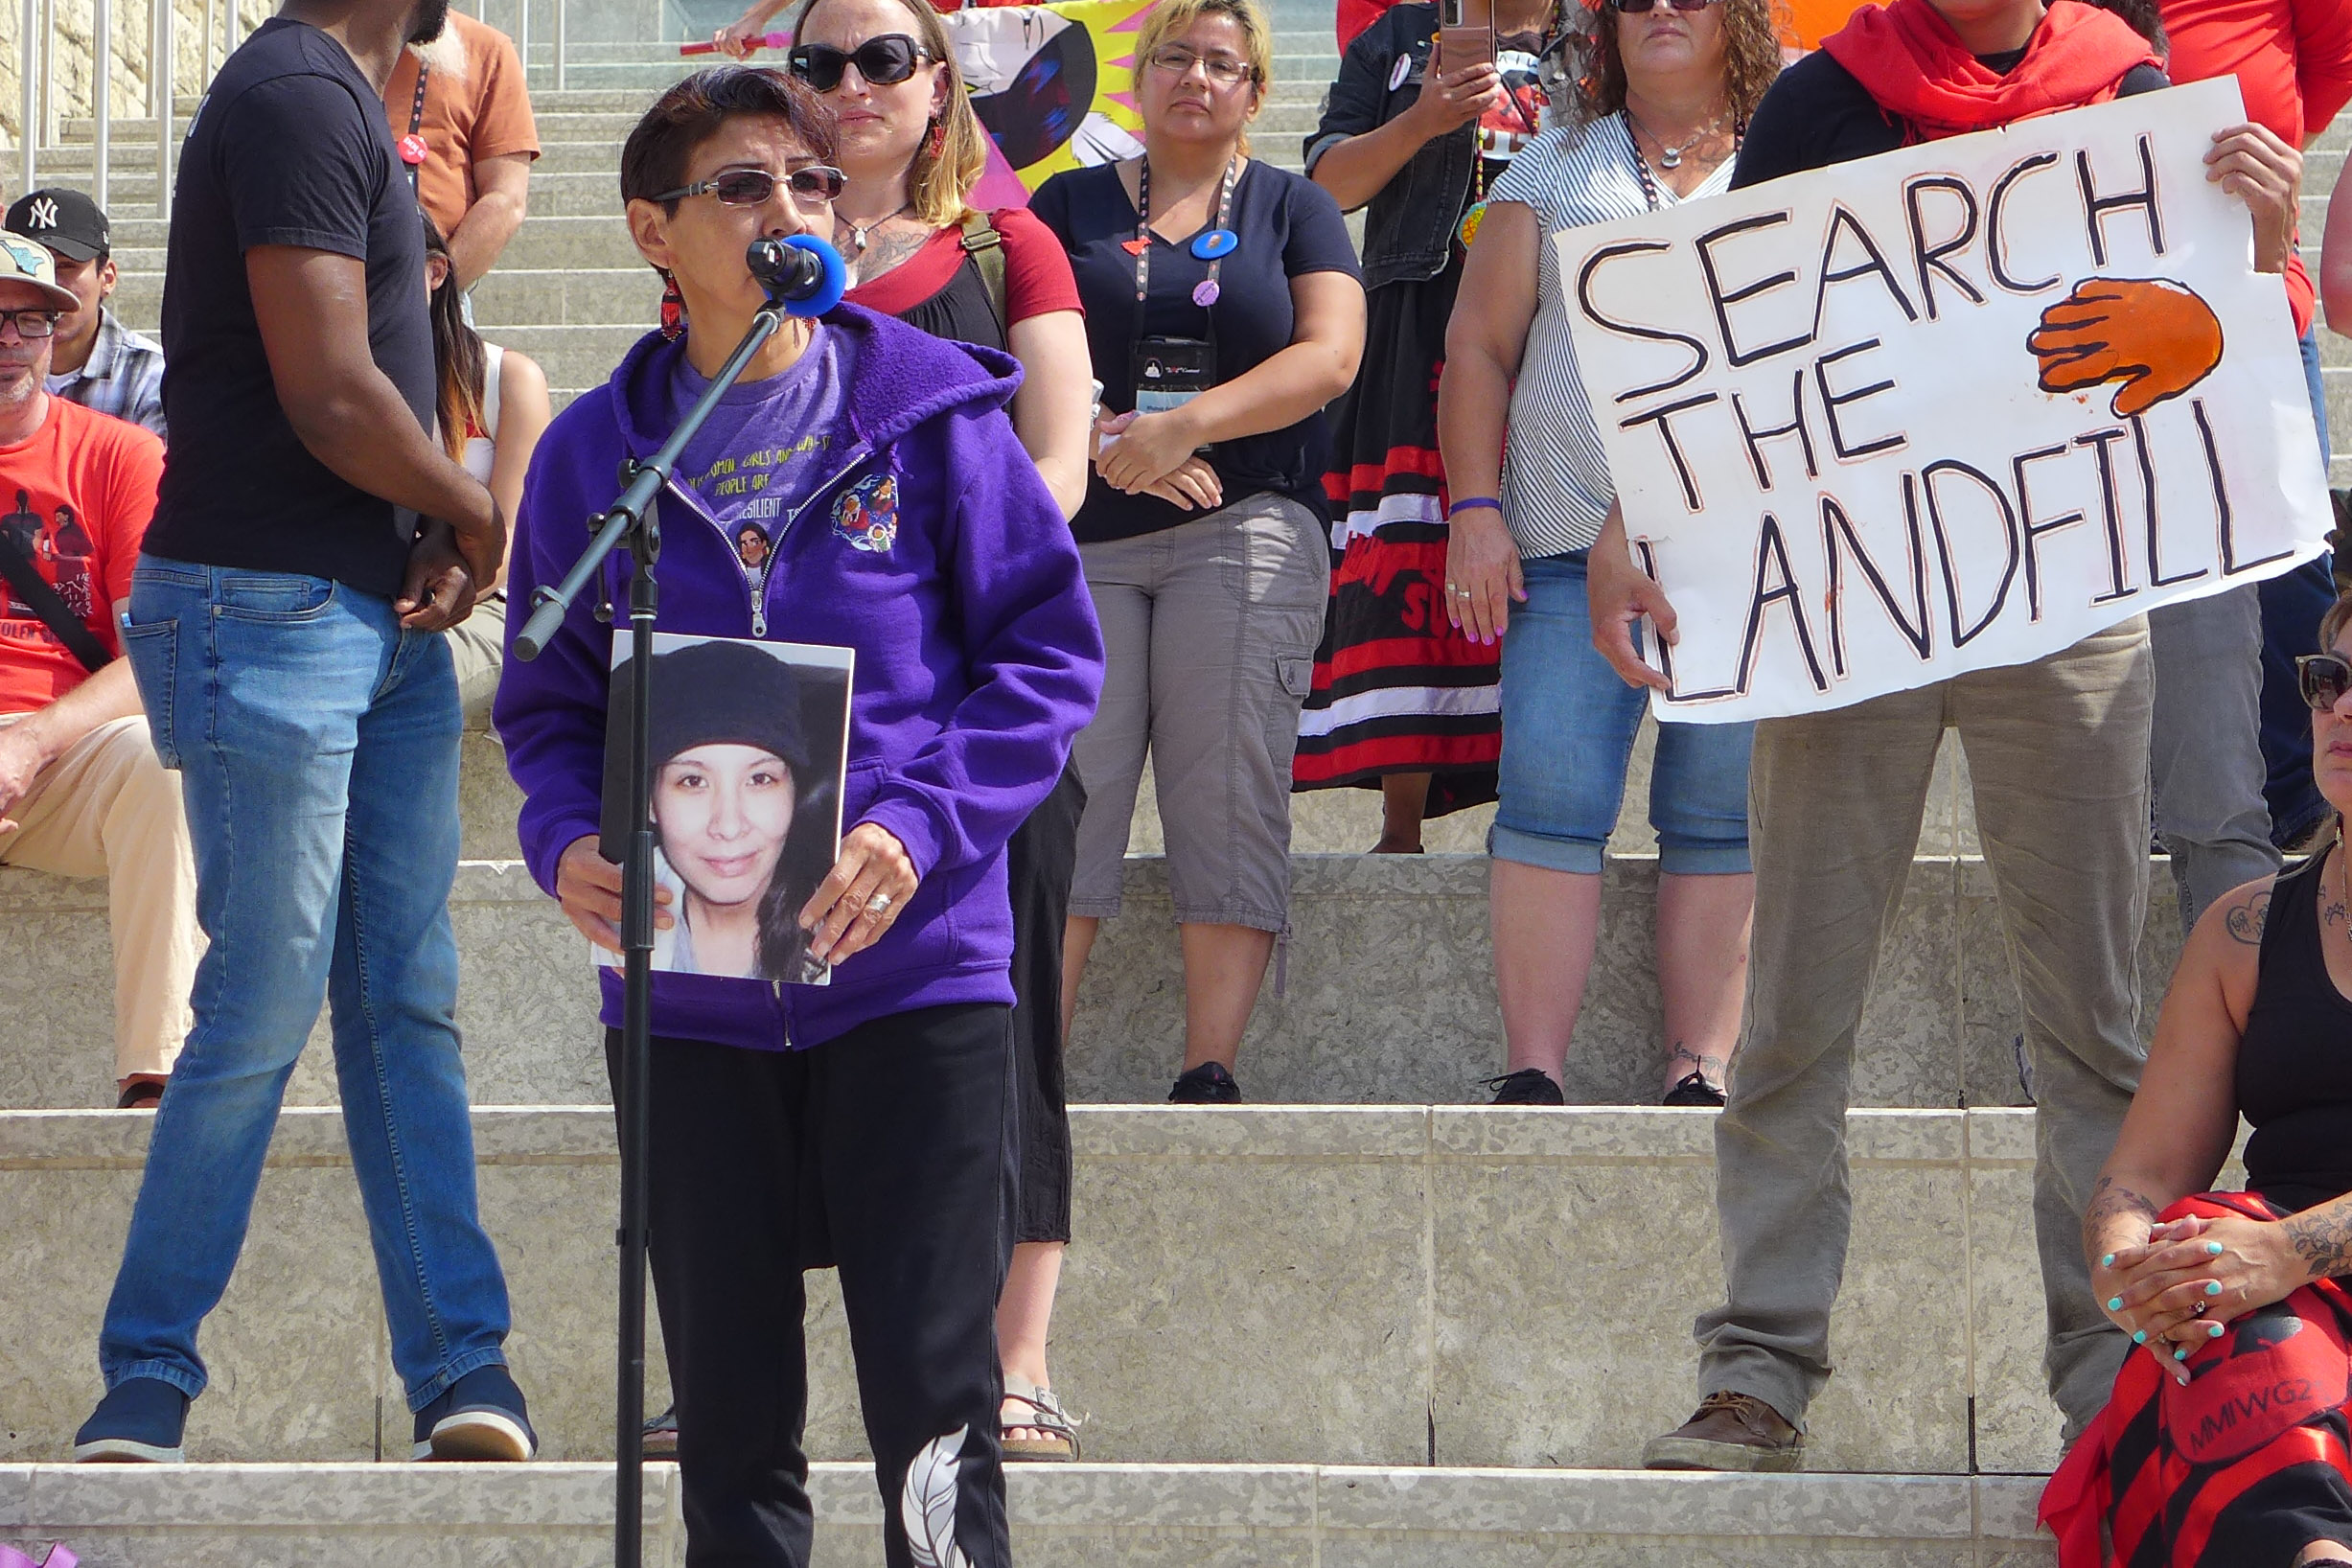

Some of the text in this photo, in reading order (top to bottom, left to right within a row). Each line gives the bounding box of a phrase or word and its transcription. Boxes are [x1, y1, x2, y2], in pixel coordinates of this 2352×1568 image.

[28, 197, 58, 229] NY
[1579, 133, 2166, 404] SEARCH
[715, 476, 747, 496] PEOPLE
[1618, 336, 1907, 512] THE
[1637, 398, 2296, 702] LANDFILL
